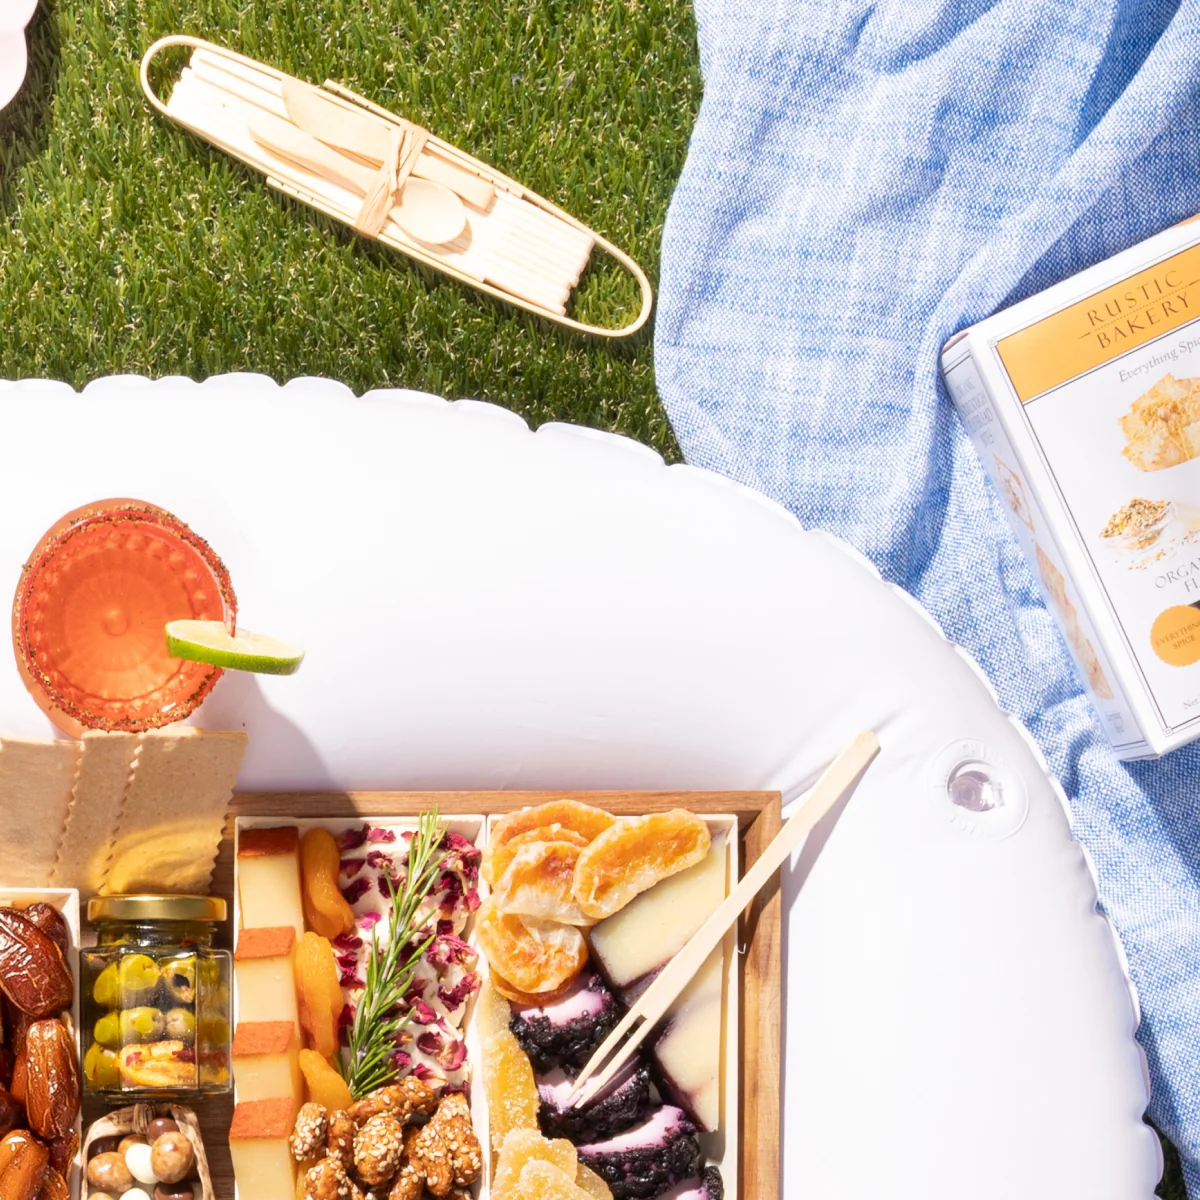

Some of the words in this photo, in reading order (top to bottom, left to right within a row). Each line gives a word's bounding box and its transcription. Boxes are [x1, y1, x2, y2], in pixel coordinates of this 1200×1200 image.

[1087, 270, 1182, 326] RUSTIC
[1097, 292, 1188, 349] BAKERY
[1118, 348, 1179, 383] Everything
[1155, 558, 1200, 588] ORGA
[1155, 621, 1200, 648] EVERYTHIN
[1172, 635, 1196, 649] SPICE
